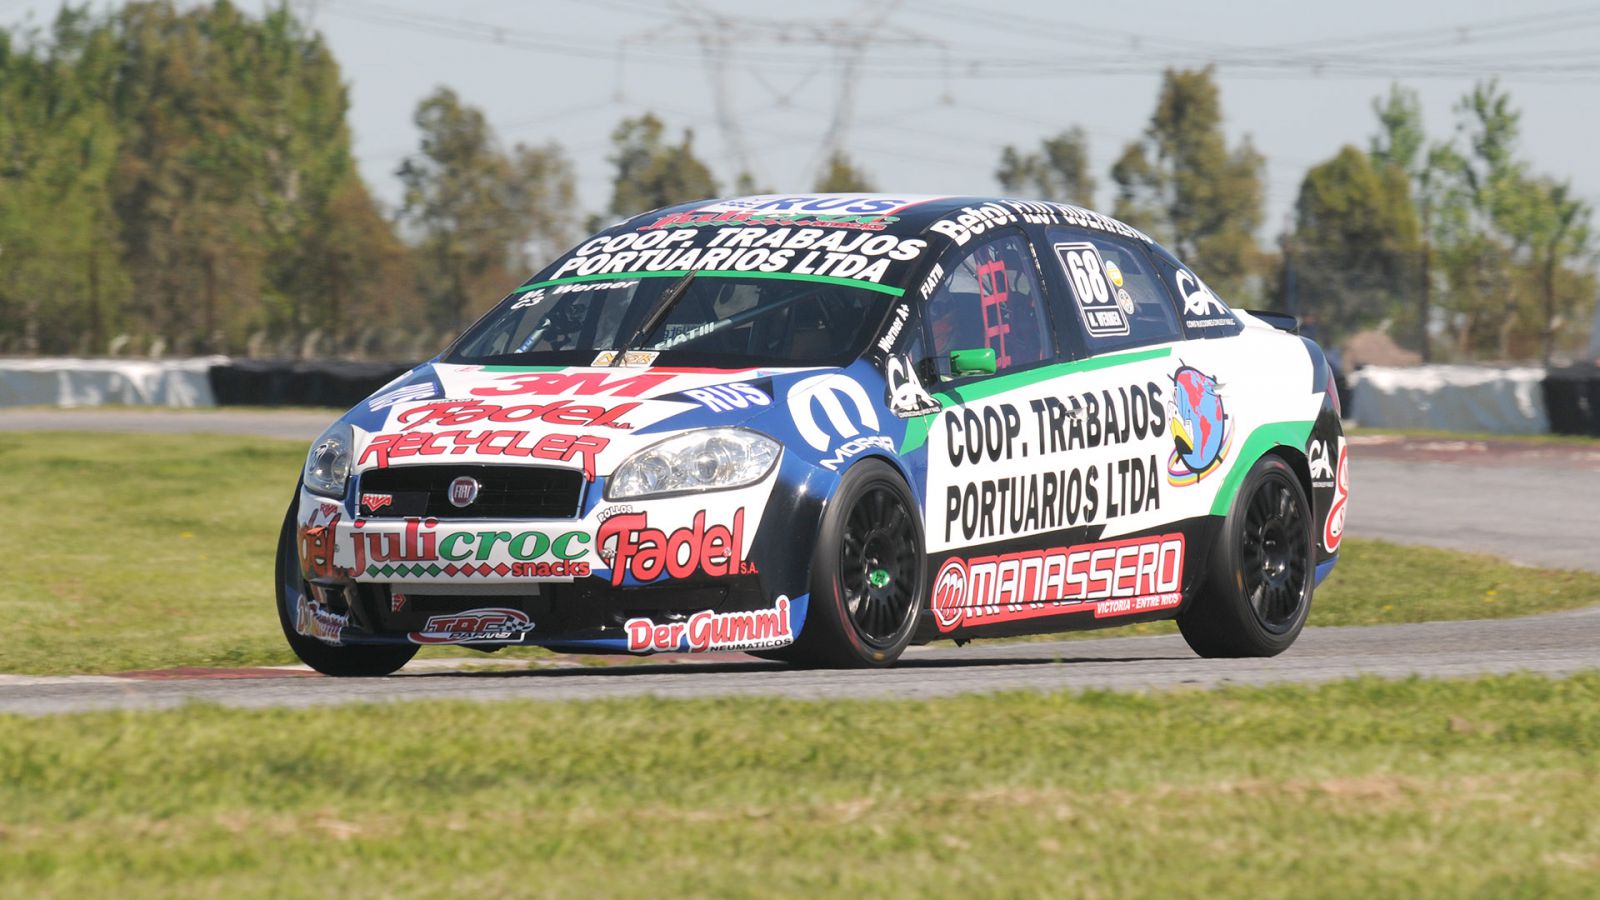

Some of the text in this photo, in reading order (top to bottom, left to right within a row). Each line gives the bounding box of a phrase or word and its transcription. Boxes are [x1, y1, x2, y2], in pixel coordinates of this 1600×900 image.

[755, 198, 904, 213] RUS
[576, 227, 927, 261] COOP. TRABAJOS
[550, 248, 890, 283] PORTUARIOS LTDA
[1067, 250, 1109, 304] 68
[551, 281, 640, 295] Werner
[878, 317, 904, 353] Werner
[470, 373, 678, 397] 3M
[683, 382, 772, 413] RUS
[397, 400, 643, 431] Fadel
[945, 381, 1166, 467] COOP. TRABAJOS
[358, 430, 610, 484] RECYCLER
[820, 436, 897, 471] MOPAR
[361, 494, 392, 512] RIVA
[597, 505, 633, 522] POLLOS
[945, 454, 1160, 543] PORTUARIOS LTDA
[350, 517, 591, 577] julicroc
[597, 506, 745, 587] Fadel
[512, 559, 590, 577] snacks
[741, 562, 759, 575] S.A.
[966, 540, 1182, 618] MANASSERO
[1097, 600, 1130, 614] VICTORIA
[1136, 597, 1160, 609] ENTRE
[628, 599, 789, 653] Der Gummi
[710, 638, 791, 652] NEUMATICOS
